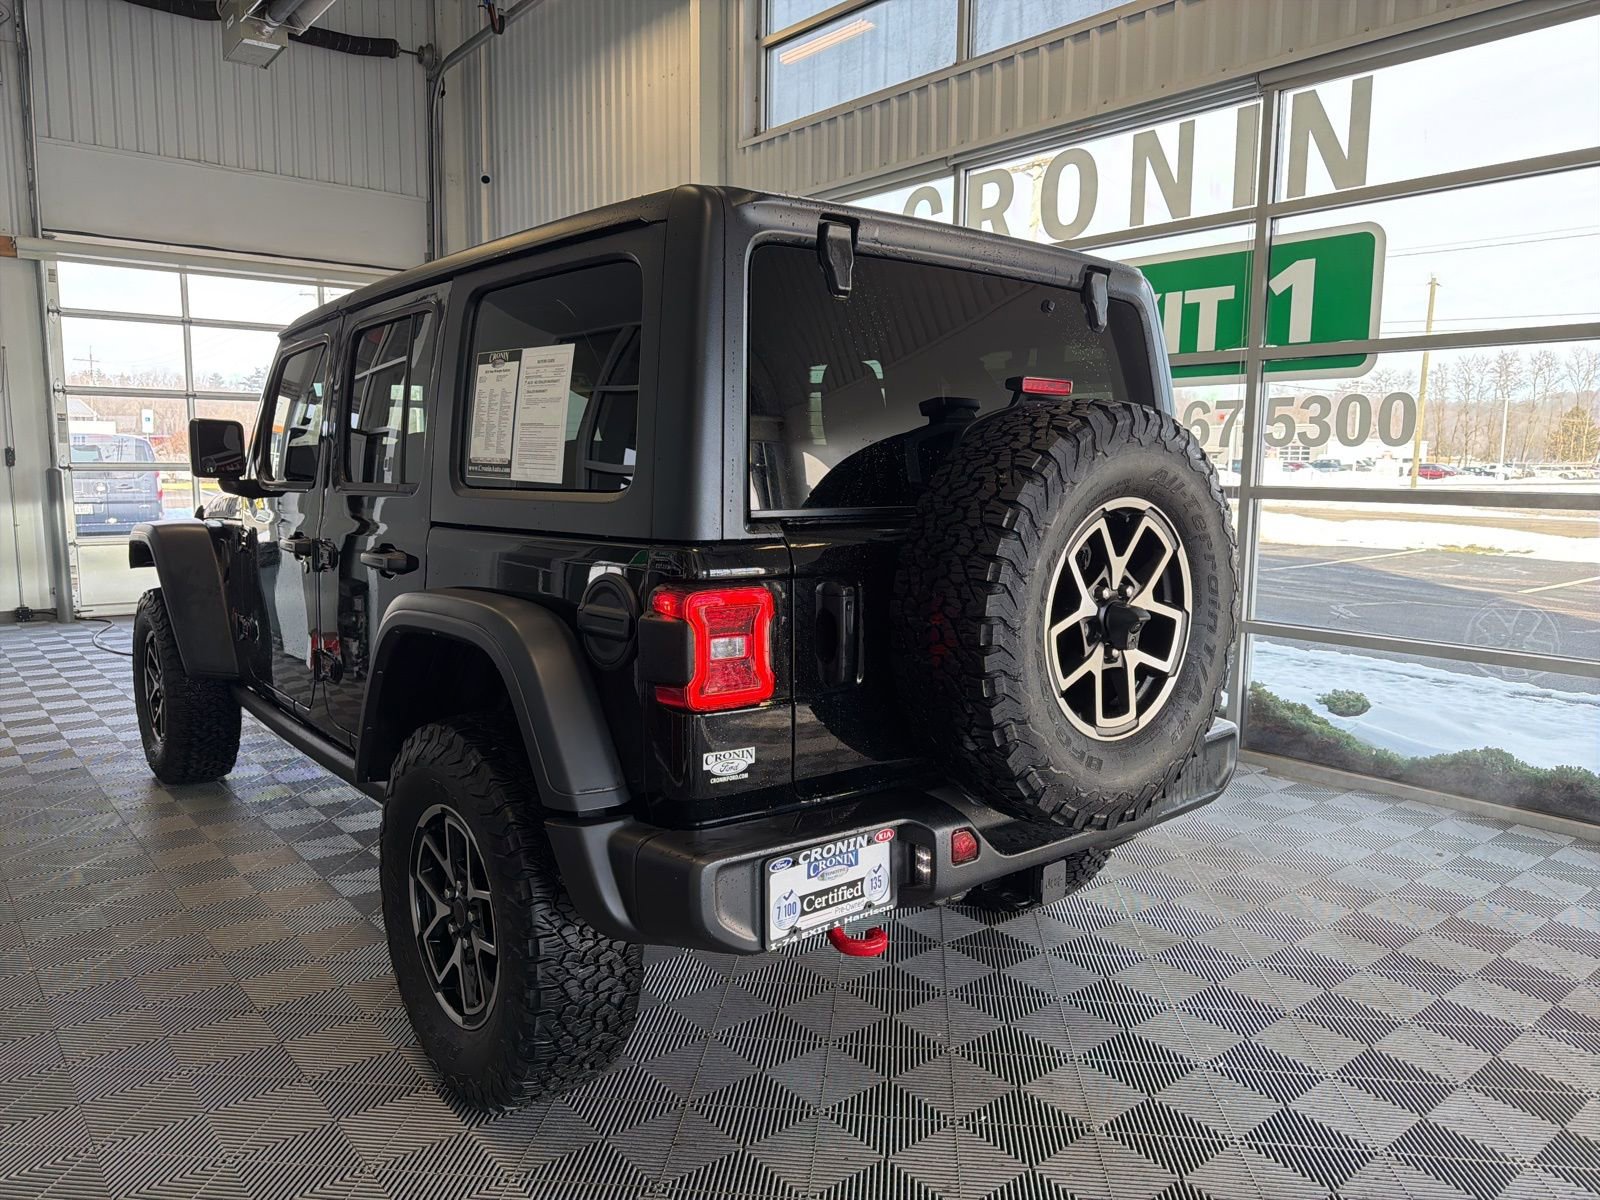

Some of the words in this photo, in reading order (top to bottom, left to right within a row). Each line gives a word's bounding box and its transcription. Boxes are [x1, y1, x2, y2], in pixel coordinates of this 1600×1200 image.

[1268, 258, 1316, 344] 1
[705, 748, 753, 766] CRONIN
[720, 761, 739, 773] Ford
[877, 831, 892, 841] KIA
[798, 834, 868, 864] CRONIN
[772, 860, 790, 871] Ford
[810, 852, 857, 876] CRONIN
[870, 874, 882, 891] 135
[803, 882, 862, 912] Certified
[769, 935, 798, 952] I-74
[801, 923, 831, 939] EXIT
[844, 904, 894, 924] Harrison
